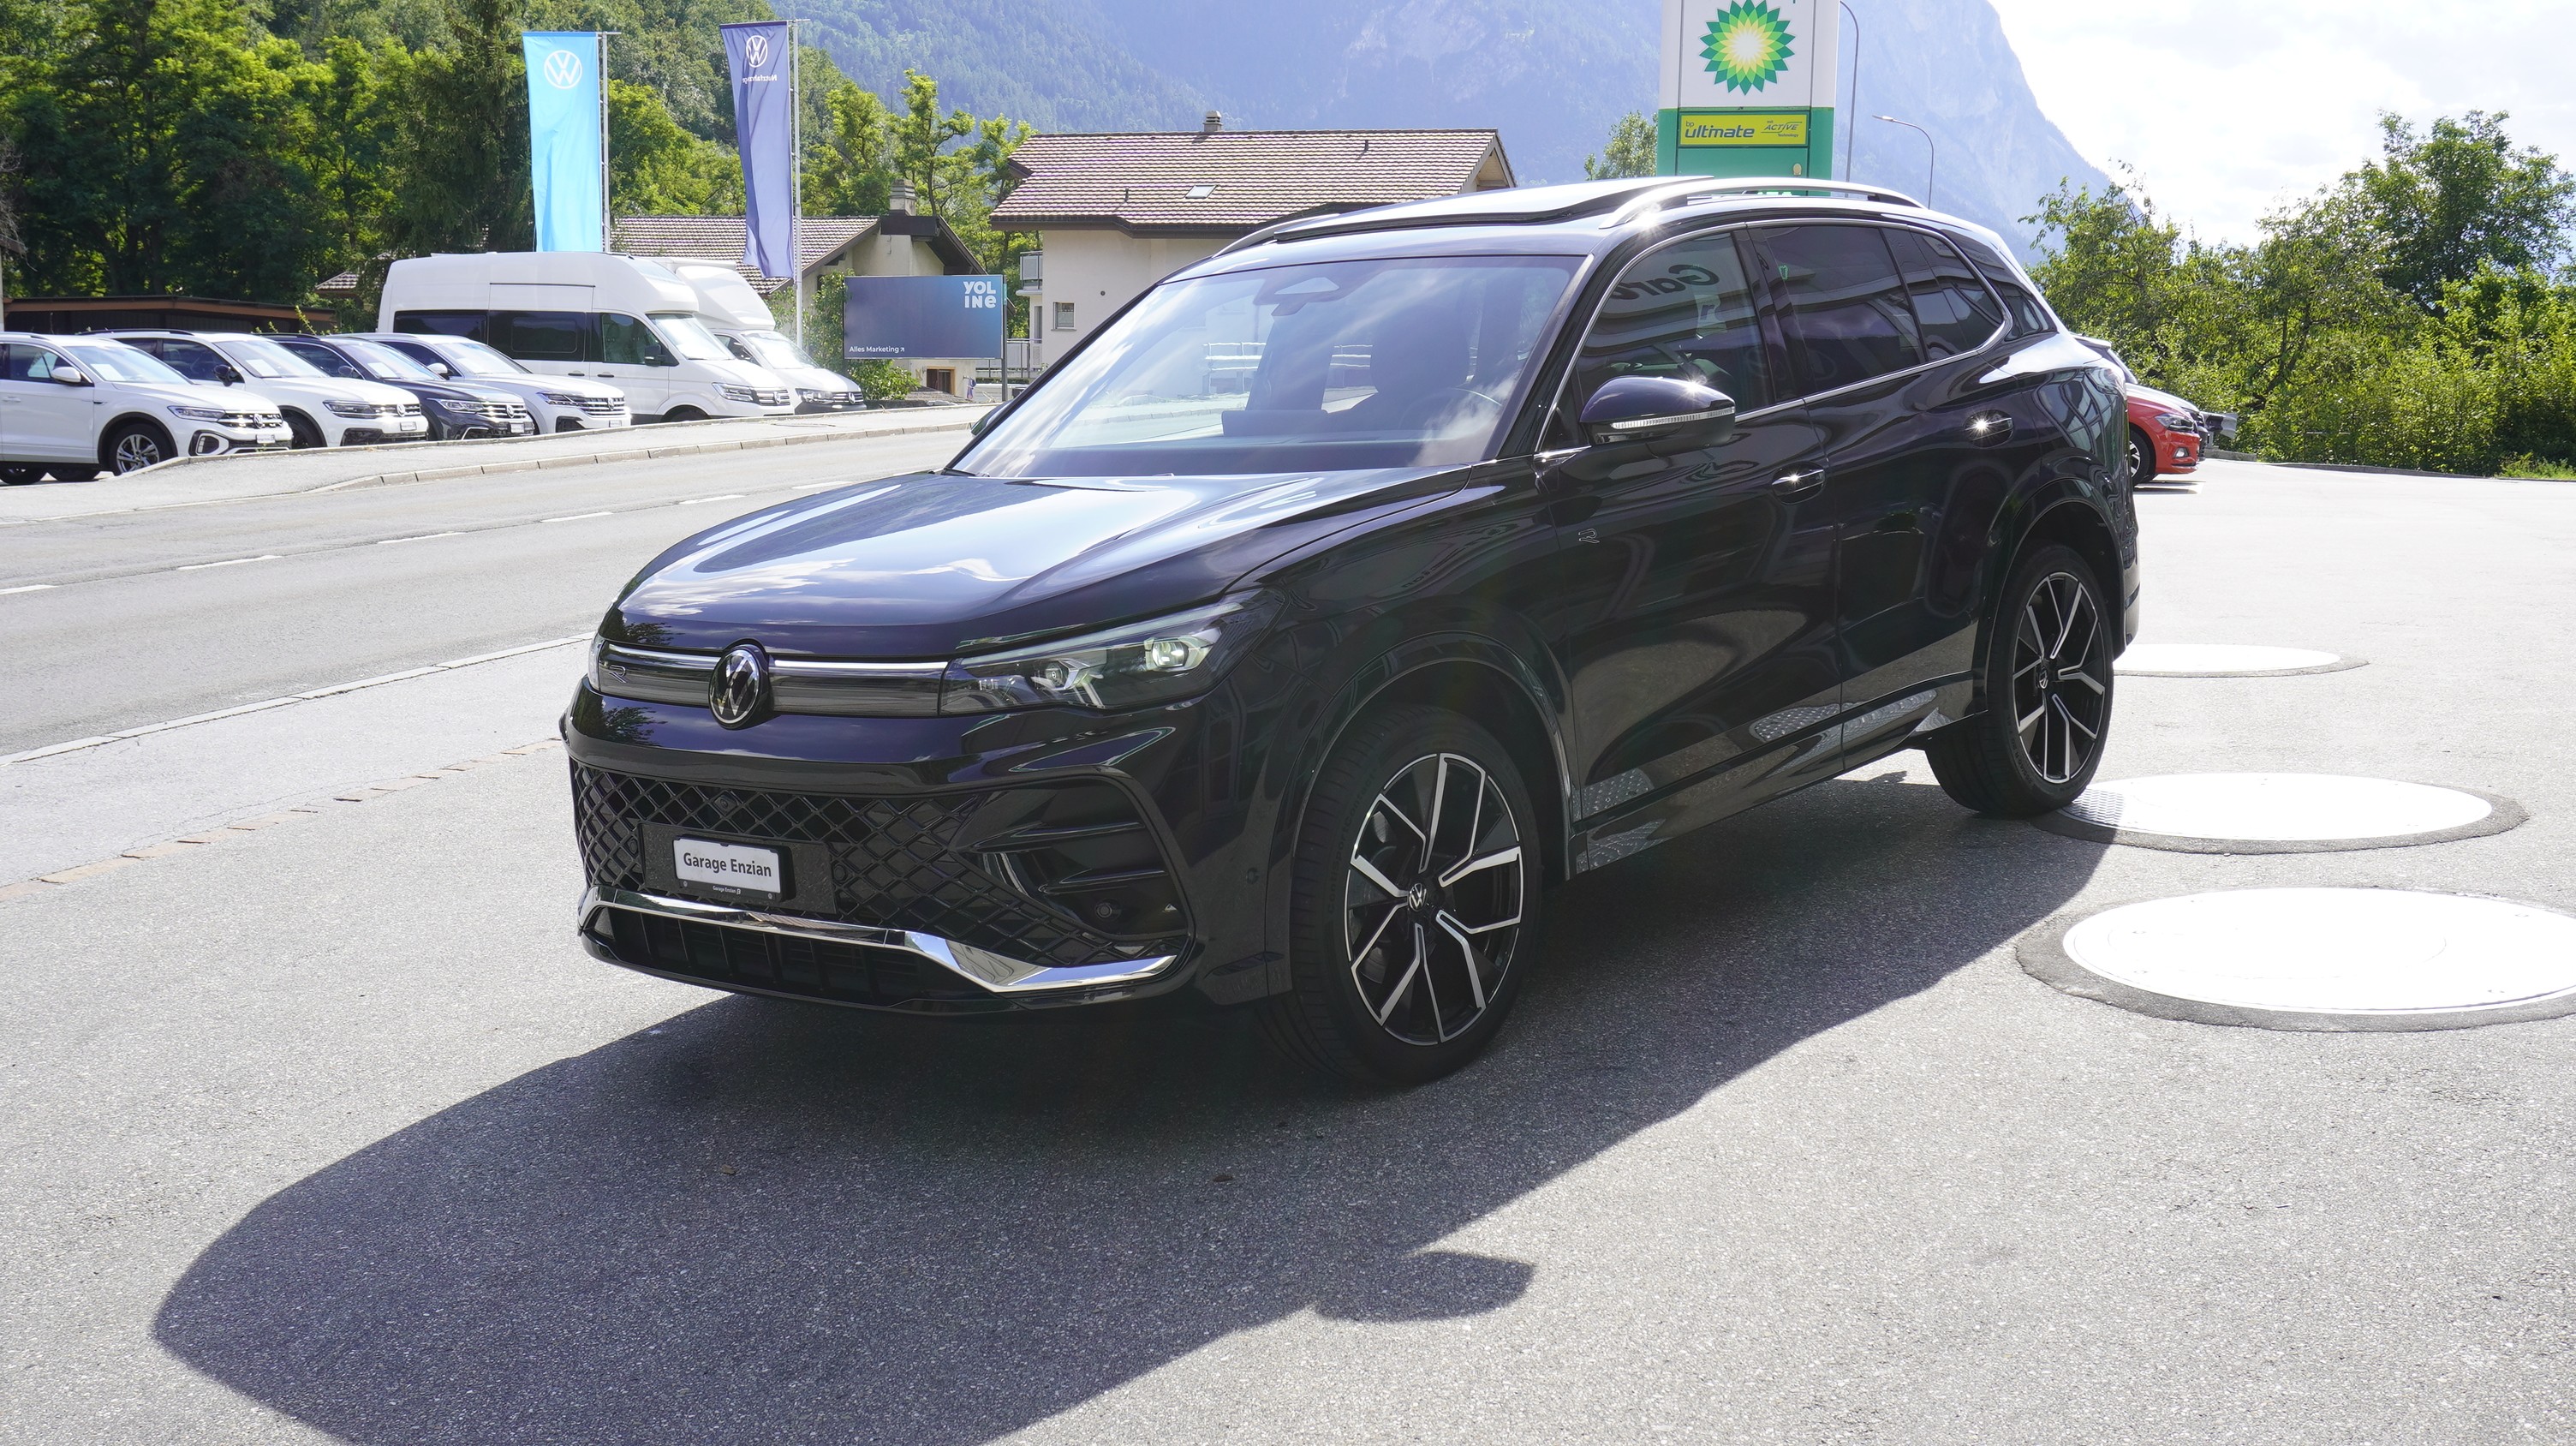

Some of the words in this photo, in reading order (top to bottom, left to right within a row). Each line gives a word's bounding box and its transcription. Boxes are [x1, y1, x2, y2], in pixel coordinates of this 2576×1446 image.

[1685, 125, 1755, 138] ultimate
[963, 281, 997, 295] YOL
[683, 852, 727, 873] Garage
[730, 858, 772, 877] Enzian
